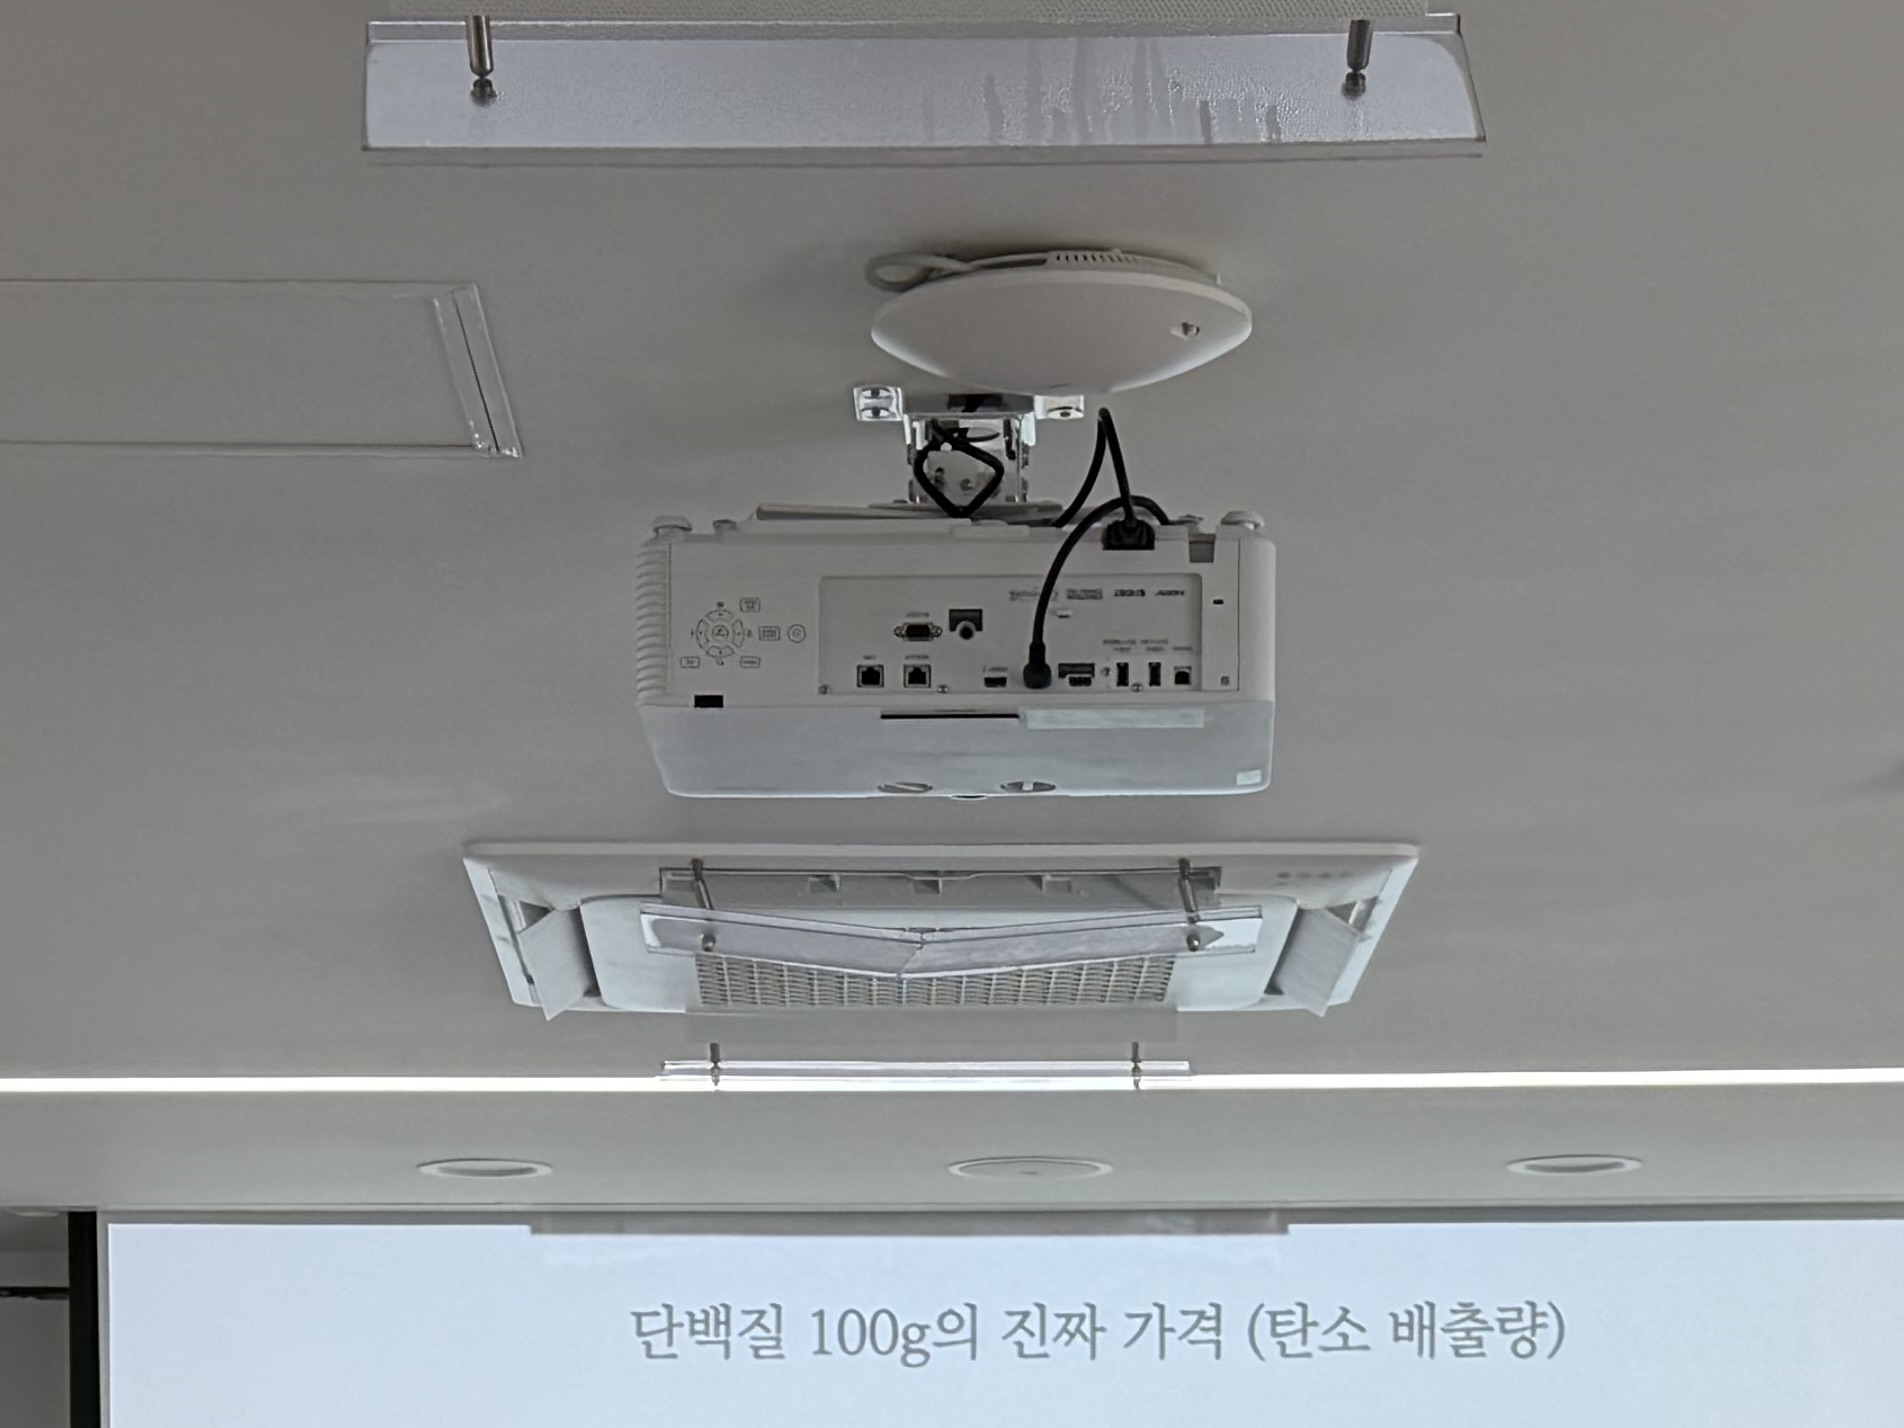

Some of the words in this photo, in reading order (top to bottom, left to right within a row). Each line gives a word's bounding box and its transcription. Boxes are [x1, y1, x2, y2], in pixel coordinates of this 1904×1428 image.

[630, 1302, 786, 1361] 단백질
[811, 1302, 978, 1368] 100g의
[1002, 1301, 1108, 1361] 진짜
[1123, 1301, 1224, 1361] 가격
[1248, 1300, 1372, 1362] (탄소
[1389, 1300, 1566, 1362] 배출량)
